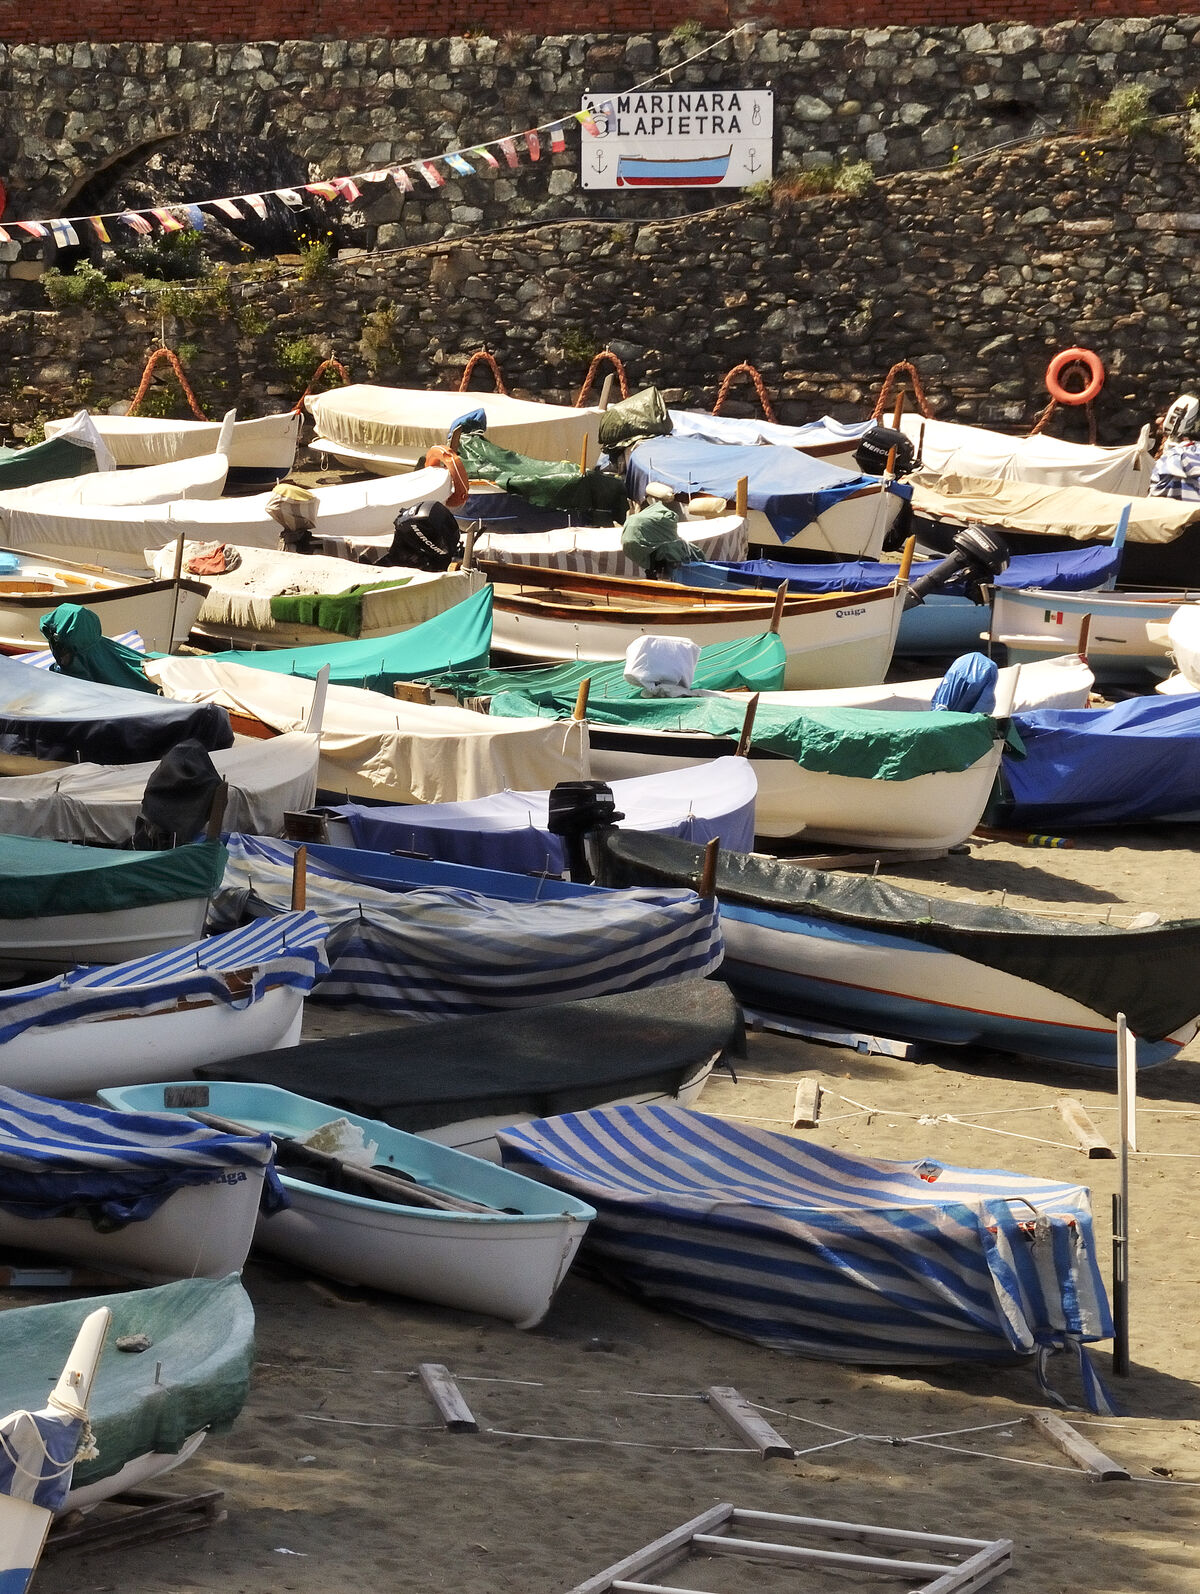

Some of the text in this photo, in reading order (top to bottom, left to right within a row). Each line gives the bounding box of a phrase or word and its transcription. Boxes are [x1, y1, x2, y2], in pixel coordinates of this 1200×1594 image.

[617, 93, 742, 114] MARINARA
[862, 441, 901, 459] MERCUY
[410, 524, 449, 555] MERCURY
[835, 608, 866, 618] Quiga
